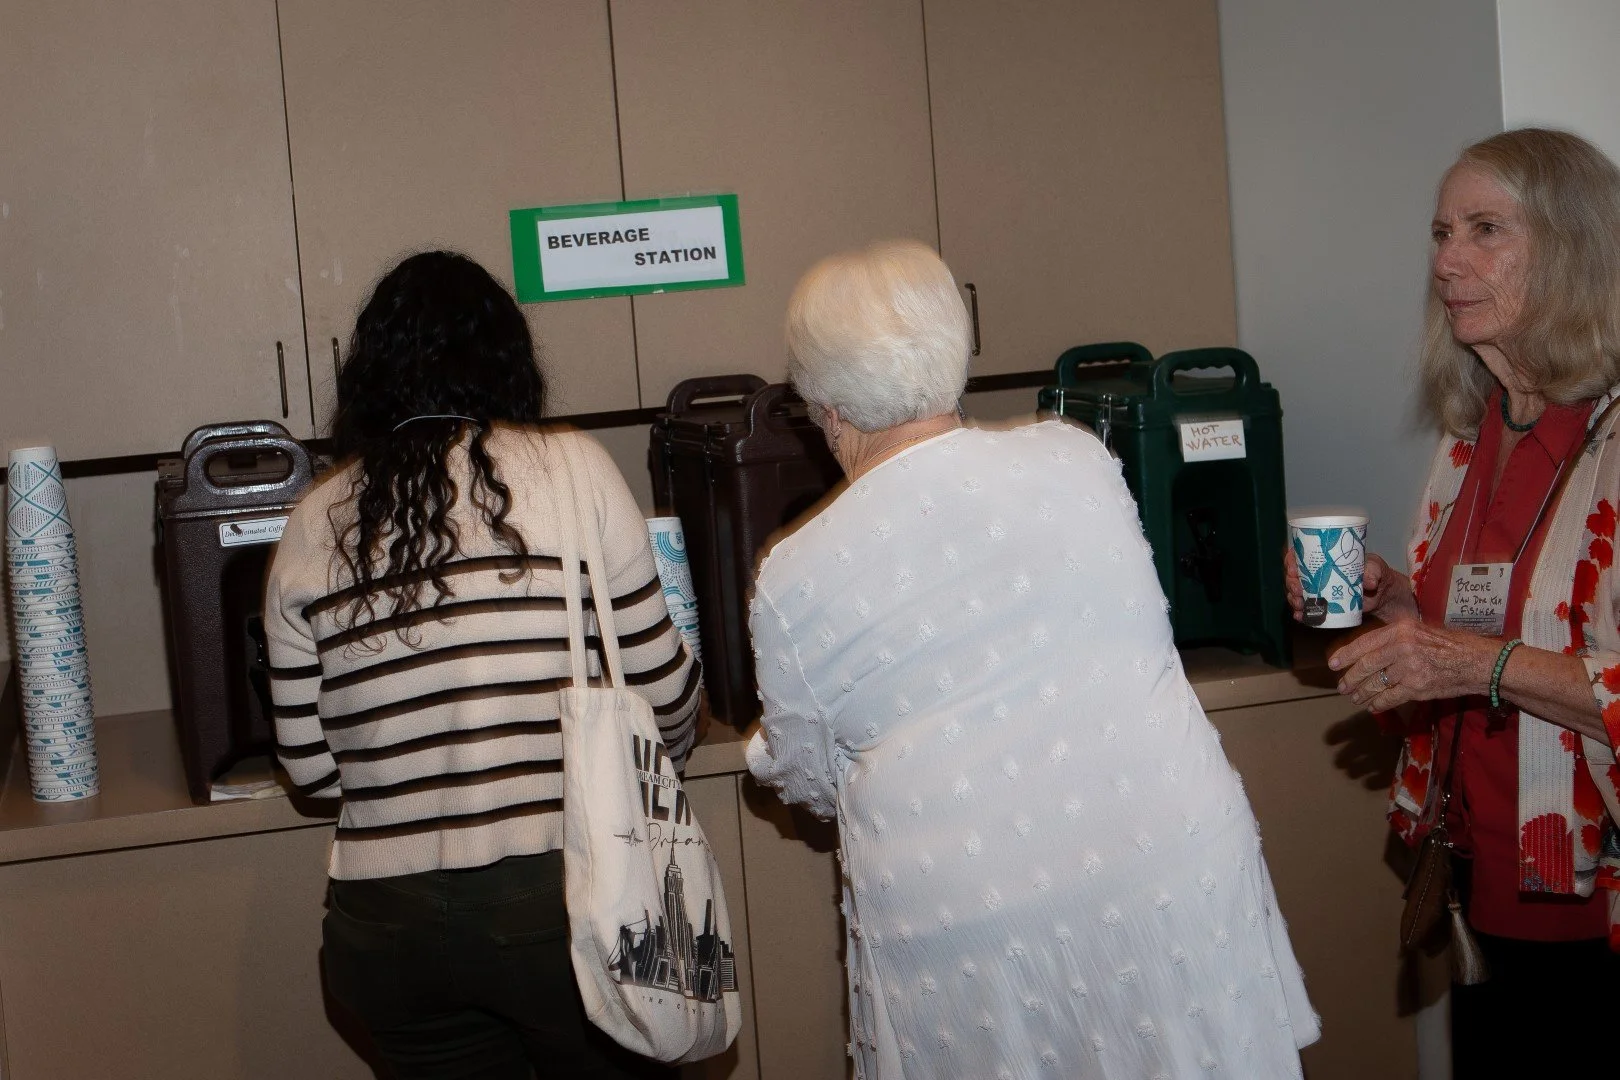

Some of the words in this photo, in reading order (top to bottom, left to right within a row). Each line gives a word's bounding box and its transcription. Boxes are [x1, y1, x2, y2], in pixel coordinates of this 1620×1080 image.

[547, 227, 650, 250] BEVERAGE
[634, 246, 717, 266] STATION
[1190, 424, 1220, 437] HOT
[1185, 434, 1242, 452] WATER
[1456, 577, 1492, 592] BROOKE
[1454, 593, 1469, 604] VAN
[1460, 604, 1496, 617] FISCHER
